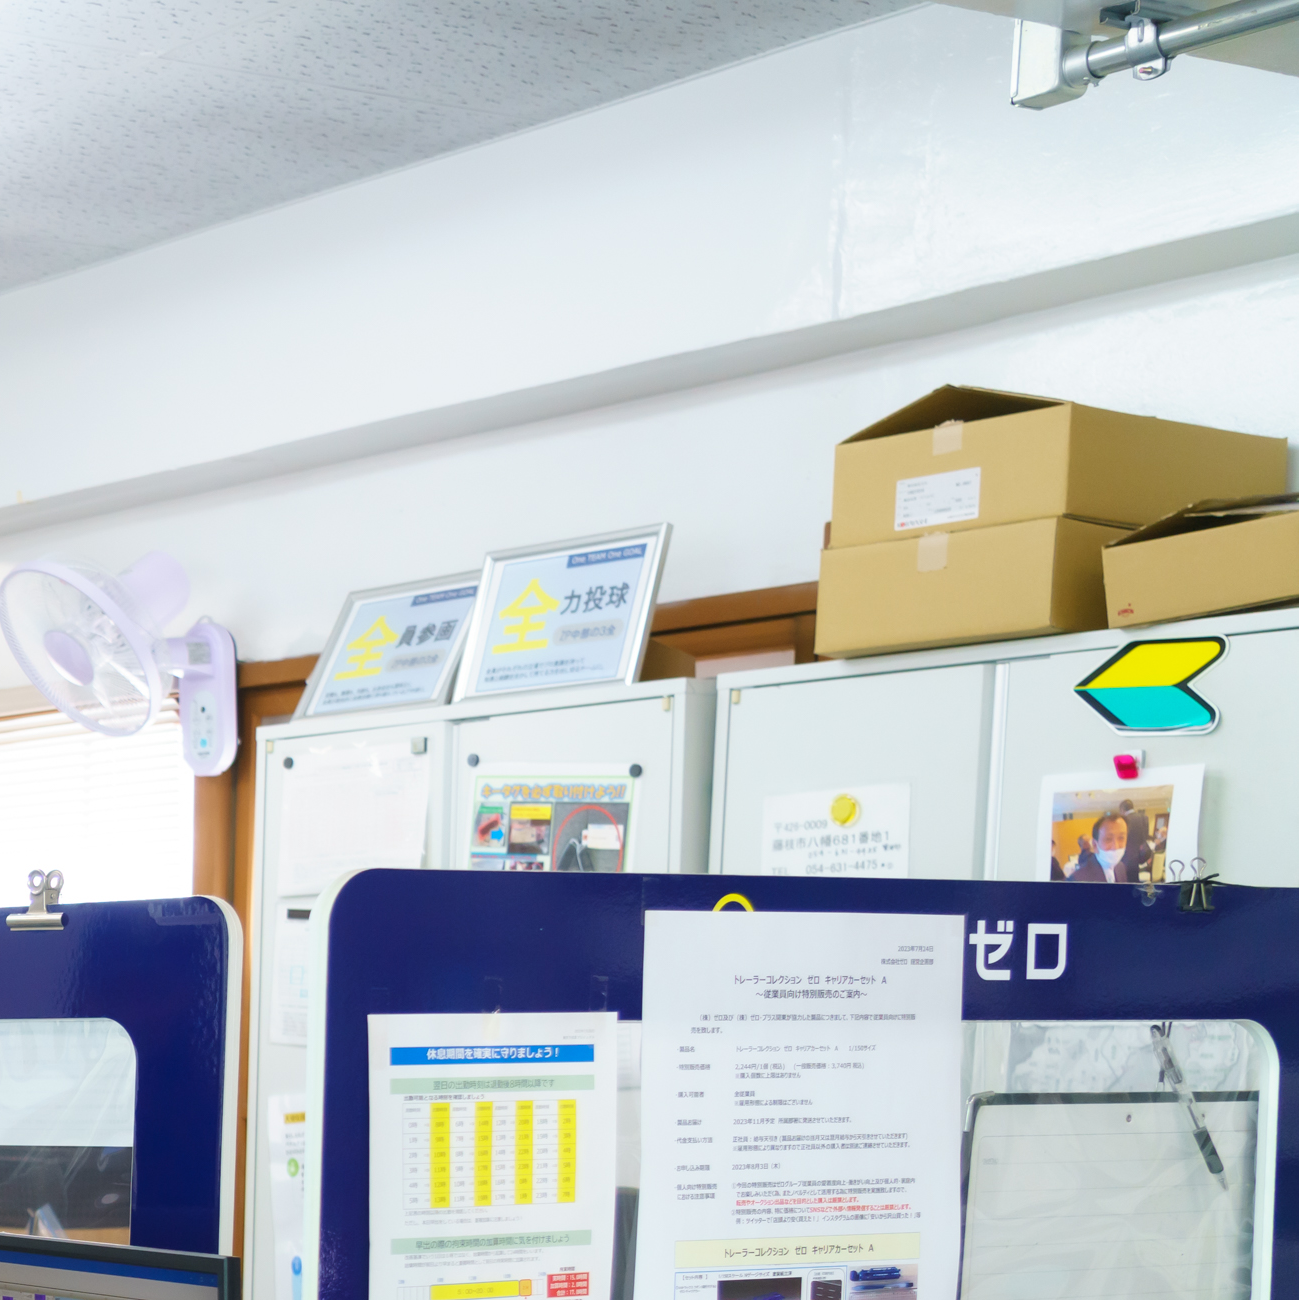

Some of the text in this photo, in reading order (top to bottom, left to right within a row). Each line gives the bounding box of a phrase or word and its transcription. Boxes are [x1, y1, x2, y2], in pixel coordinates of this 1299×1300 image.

[969, 920, 1067, 981] ゼロ
[734, 975, 887, 985] トレーラーコレクション ゼロ キャリアカーセット A
[426, 1047, 560, 1061] 休息期間を確実に守りましょう！
[724, 1243, 874, 1258] トレーラーコレクション ゼロ キャリアカーセット A
